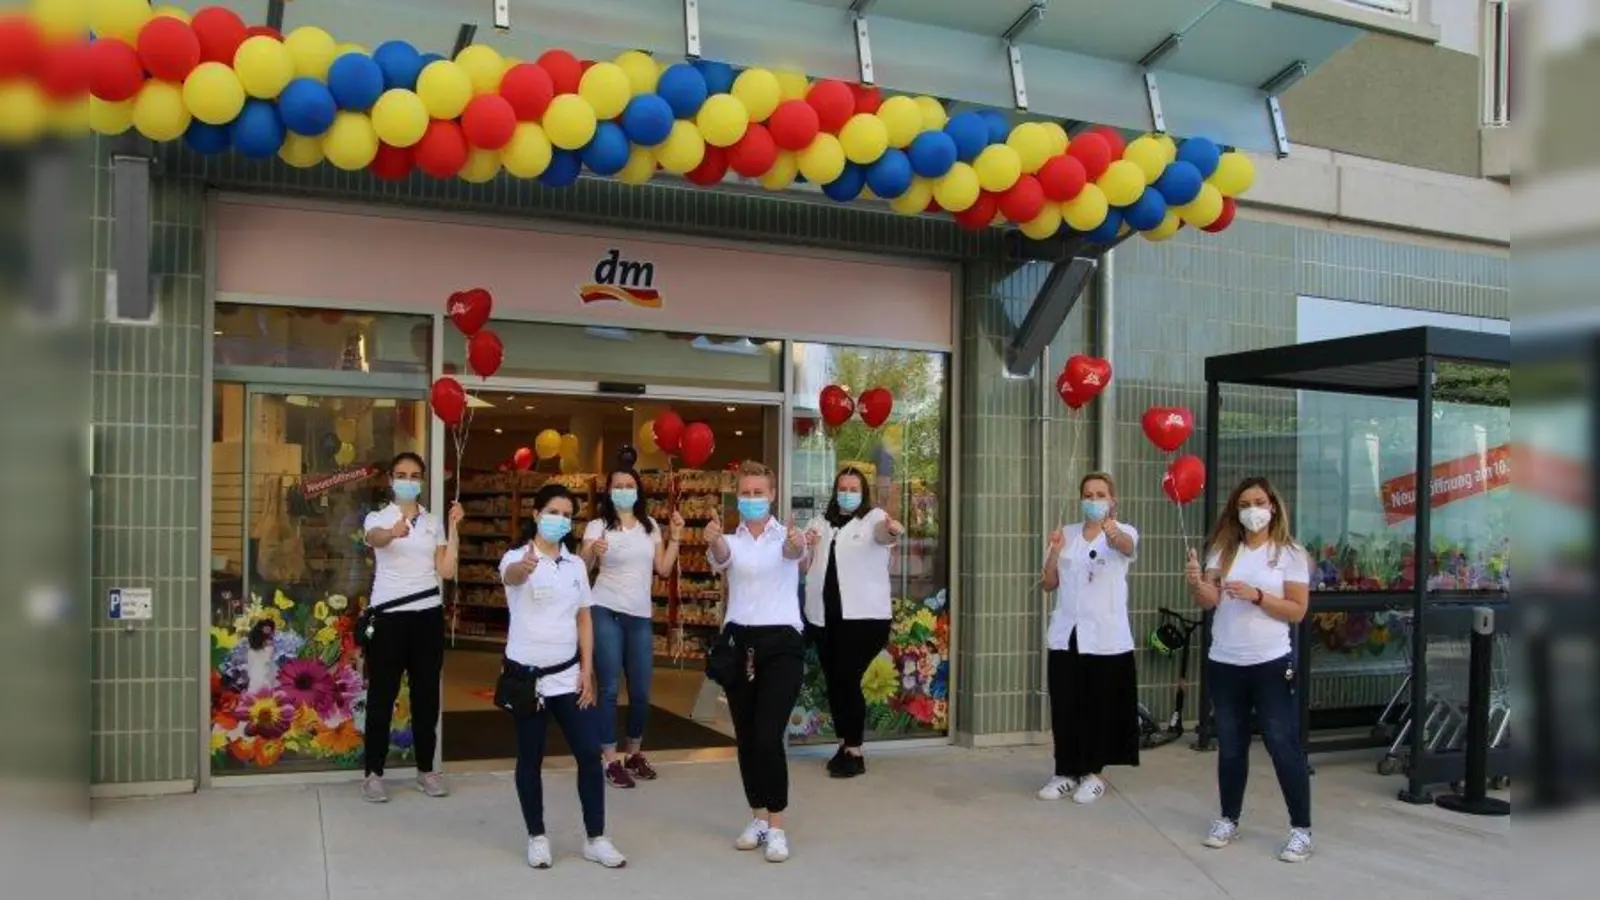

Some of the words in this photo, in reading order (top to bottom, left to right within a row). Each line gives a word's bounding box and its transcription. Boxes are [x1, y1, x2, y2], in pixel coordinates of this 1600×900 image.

[594, 249, 654, 288] dm
[1473, 465, 1493, 482] am
[110, 593, 120, 612] P
